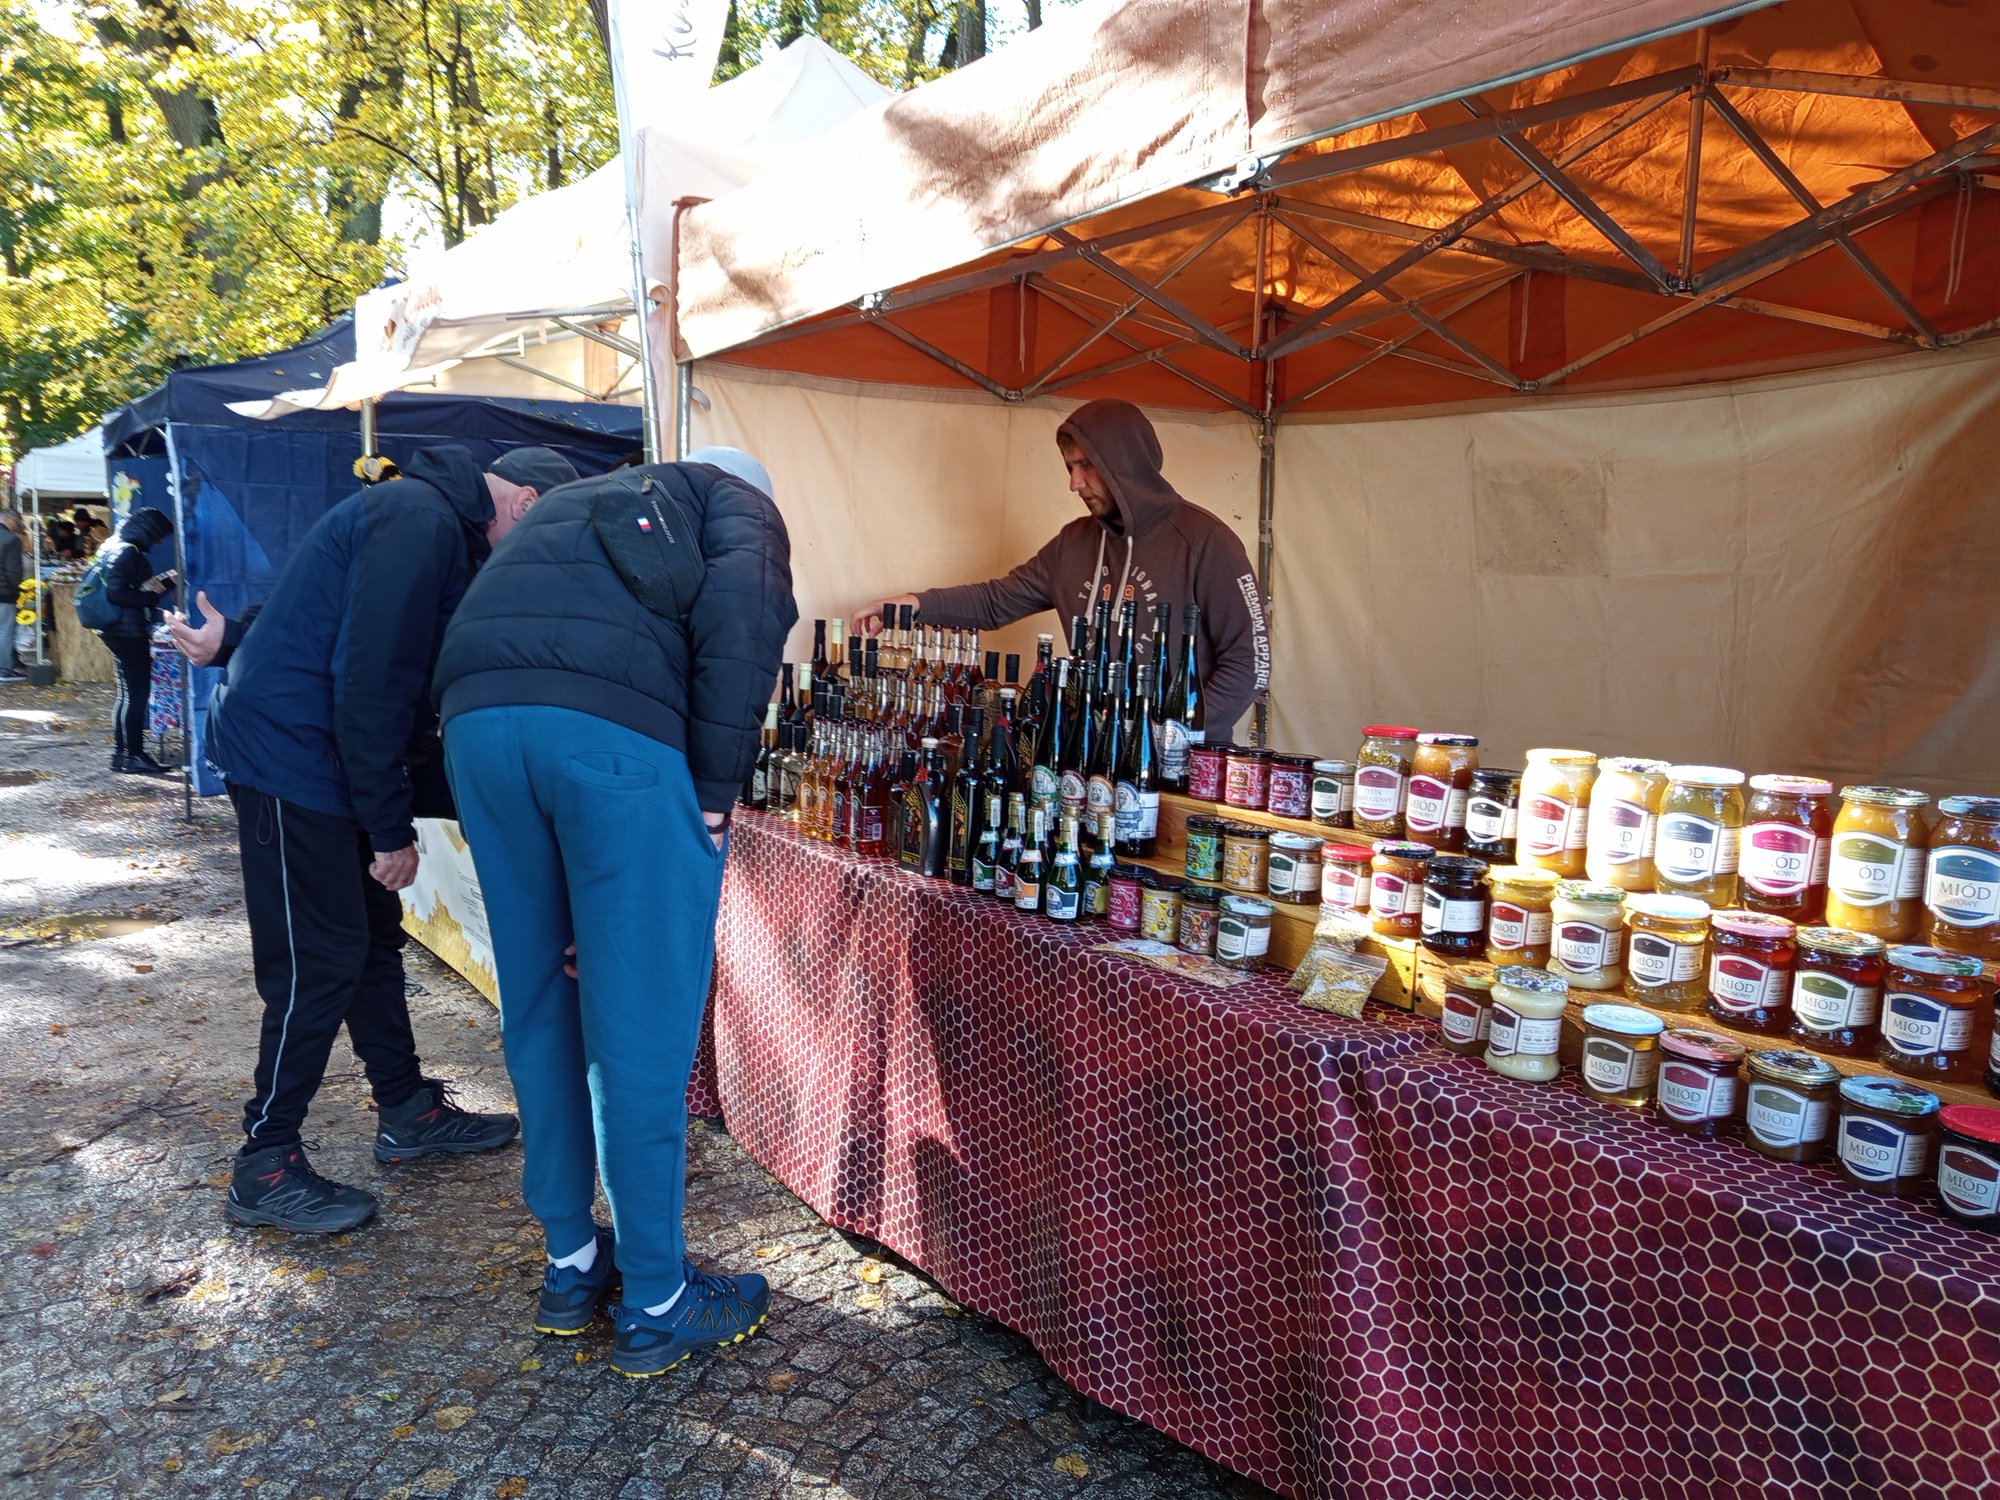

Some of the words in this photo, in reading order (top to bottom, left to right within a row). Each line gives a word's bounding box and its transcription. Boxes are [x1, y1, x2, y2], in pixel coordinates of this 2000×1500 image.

[1241, 573, 1266, 632] PREMIUM
[1253, 635, 1271, 690] APPAREL
[1940, 881, 1991, 900] MIÓD
[1720, 977, 1755, 993] MIÓD
[1803, 994, 1839, 1012] MIÓD
[1893, 1018, 1932, 1036] MIÓD
[1590, 1058, 1622, 1076] MIÓD
[1666, 1084, 1702, 1103] MIÓD
[1756, 1108, 1794, 1127] MIÓD
[1849, 1141, 1890, 1161] MIÓD
[1946, 1172, 1989, 1195] MIÓD
